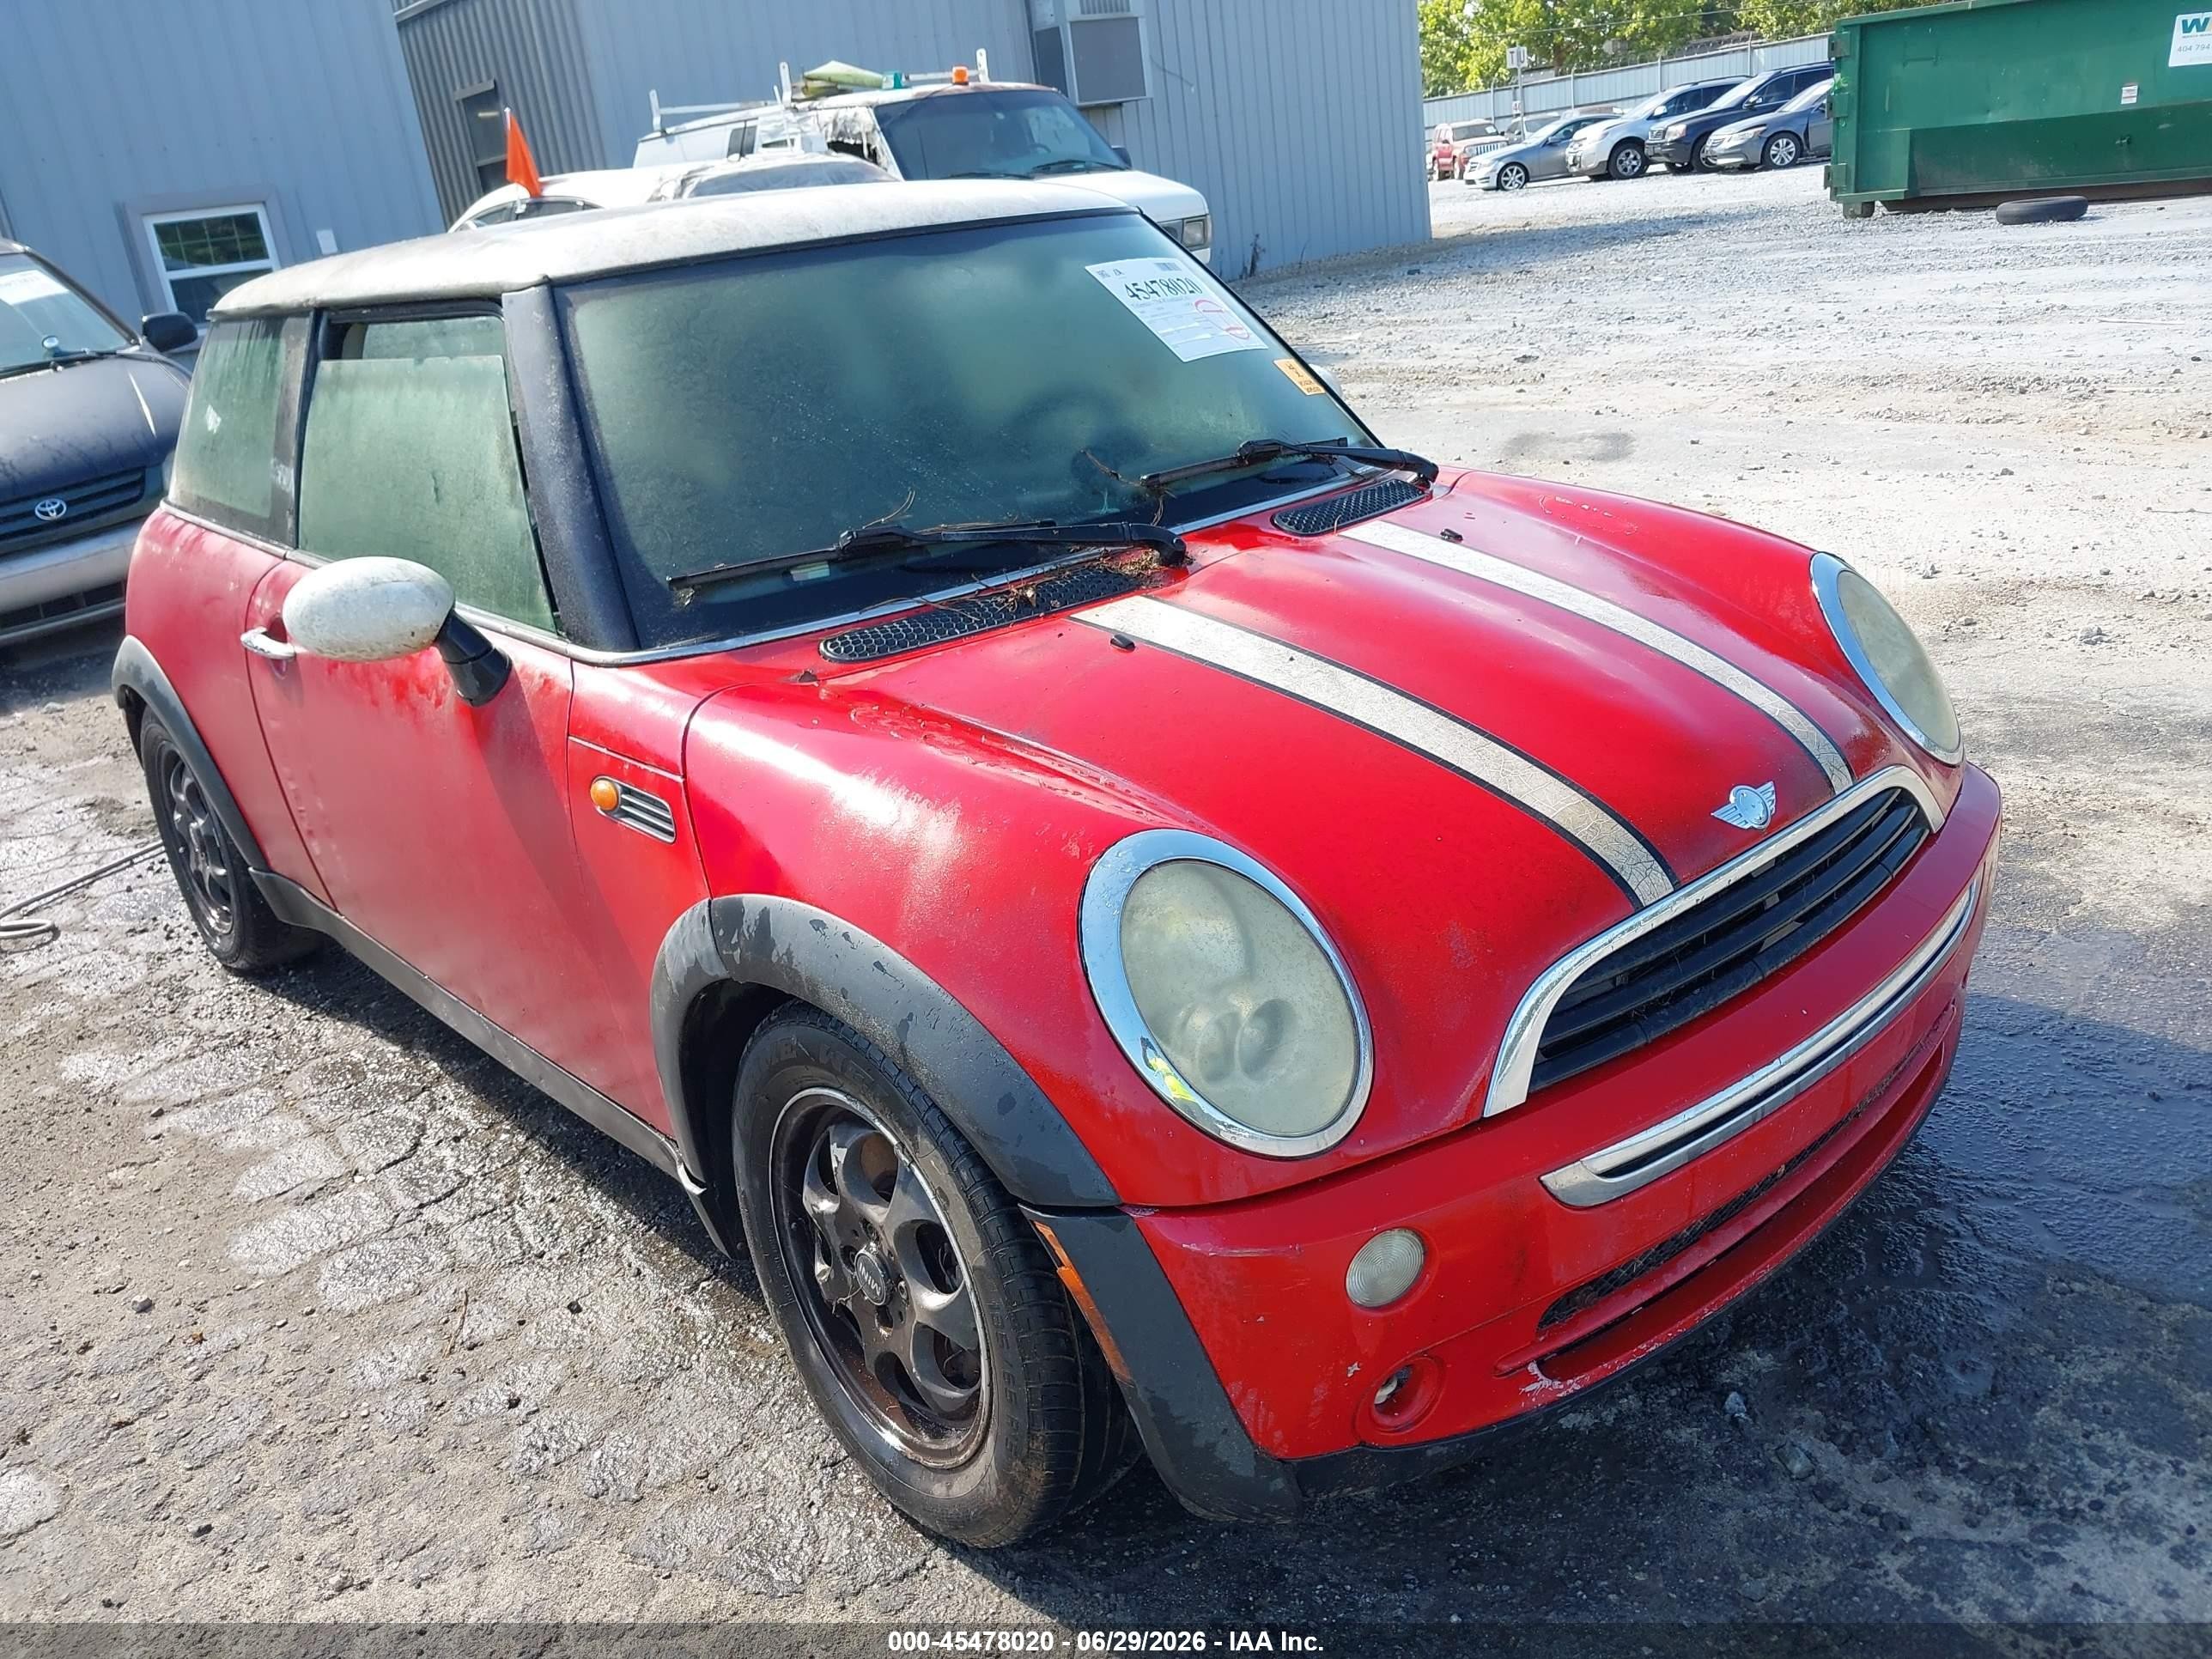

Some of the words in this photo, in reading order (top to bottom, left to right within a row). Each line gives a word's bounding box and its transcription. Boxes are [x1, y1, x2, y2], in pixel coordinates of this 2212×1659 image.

[1509, 51, 1515, 65] T
[1124, 276, 1203, 301] 45478020
[859, 1262, 881, 1297] MINI
